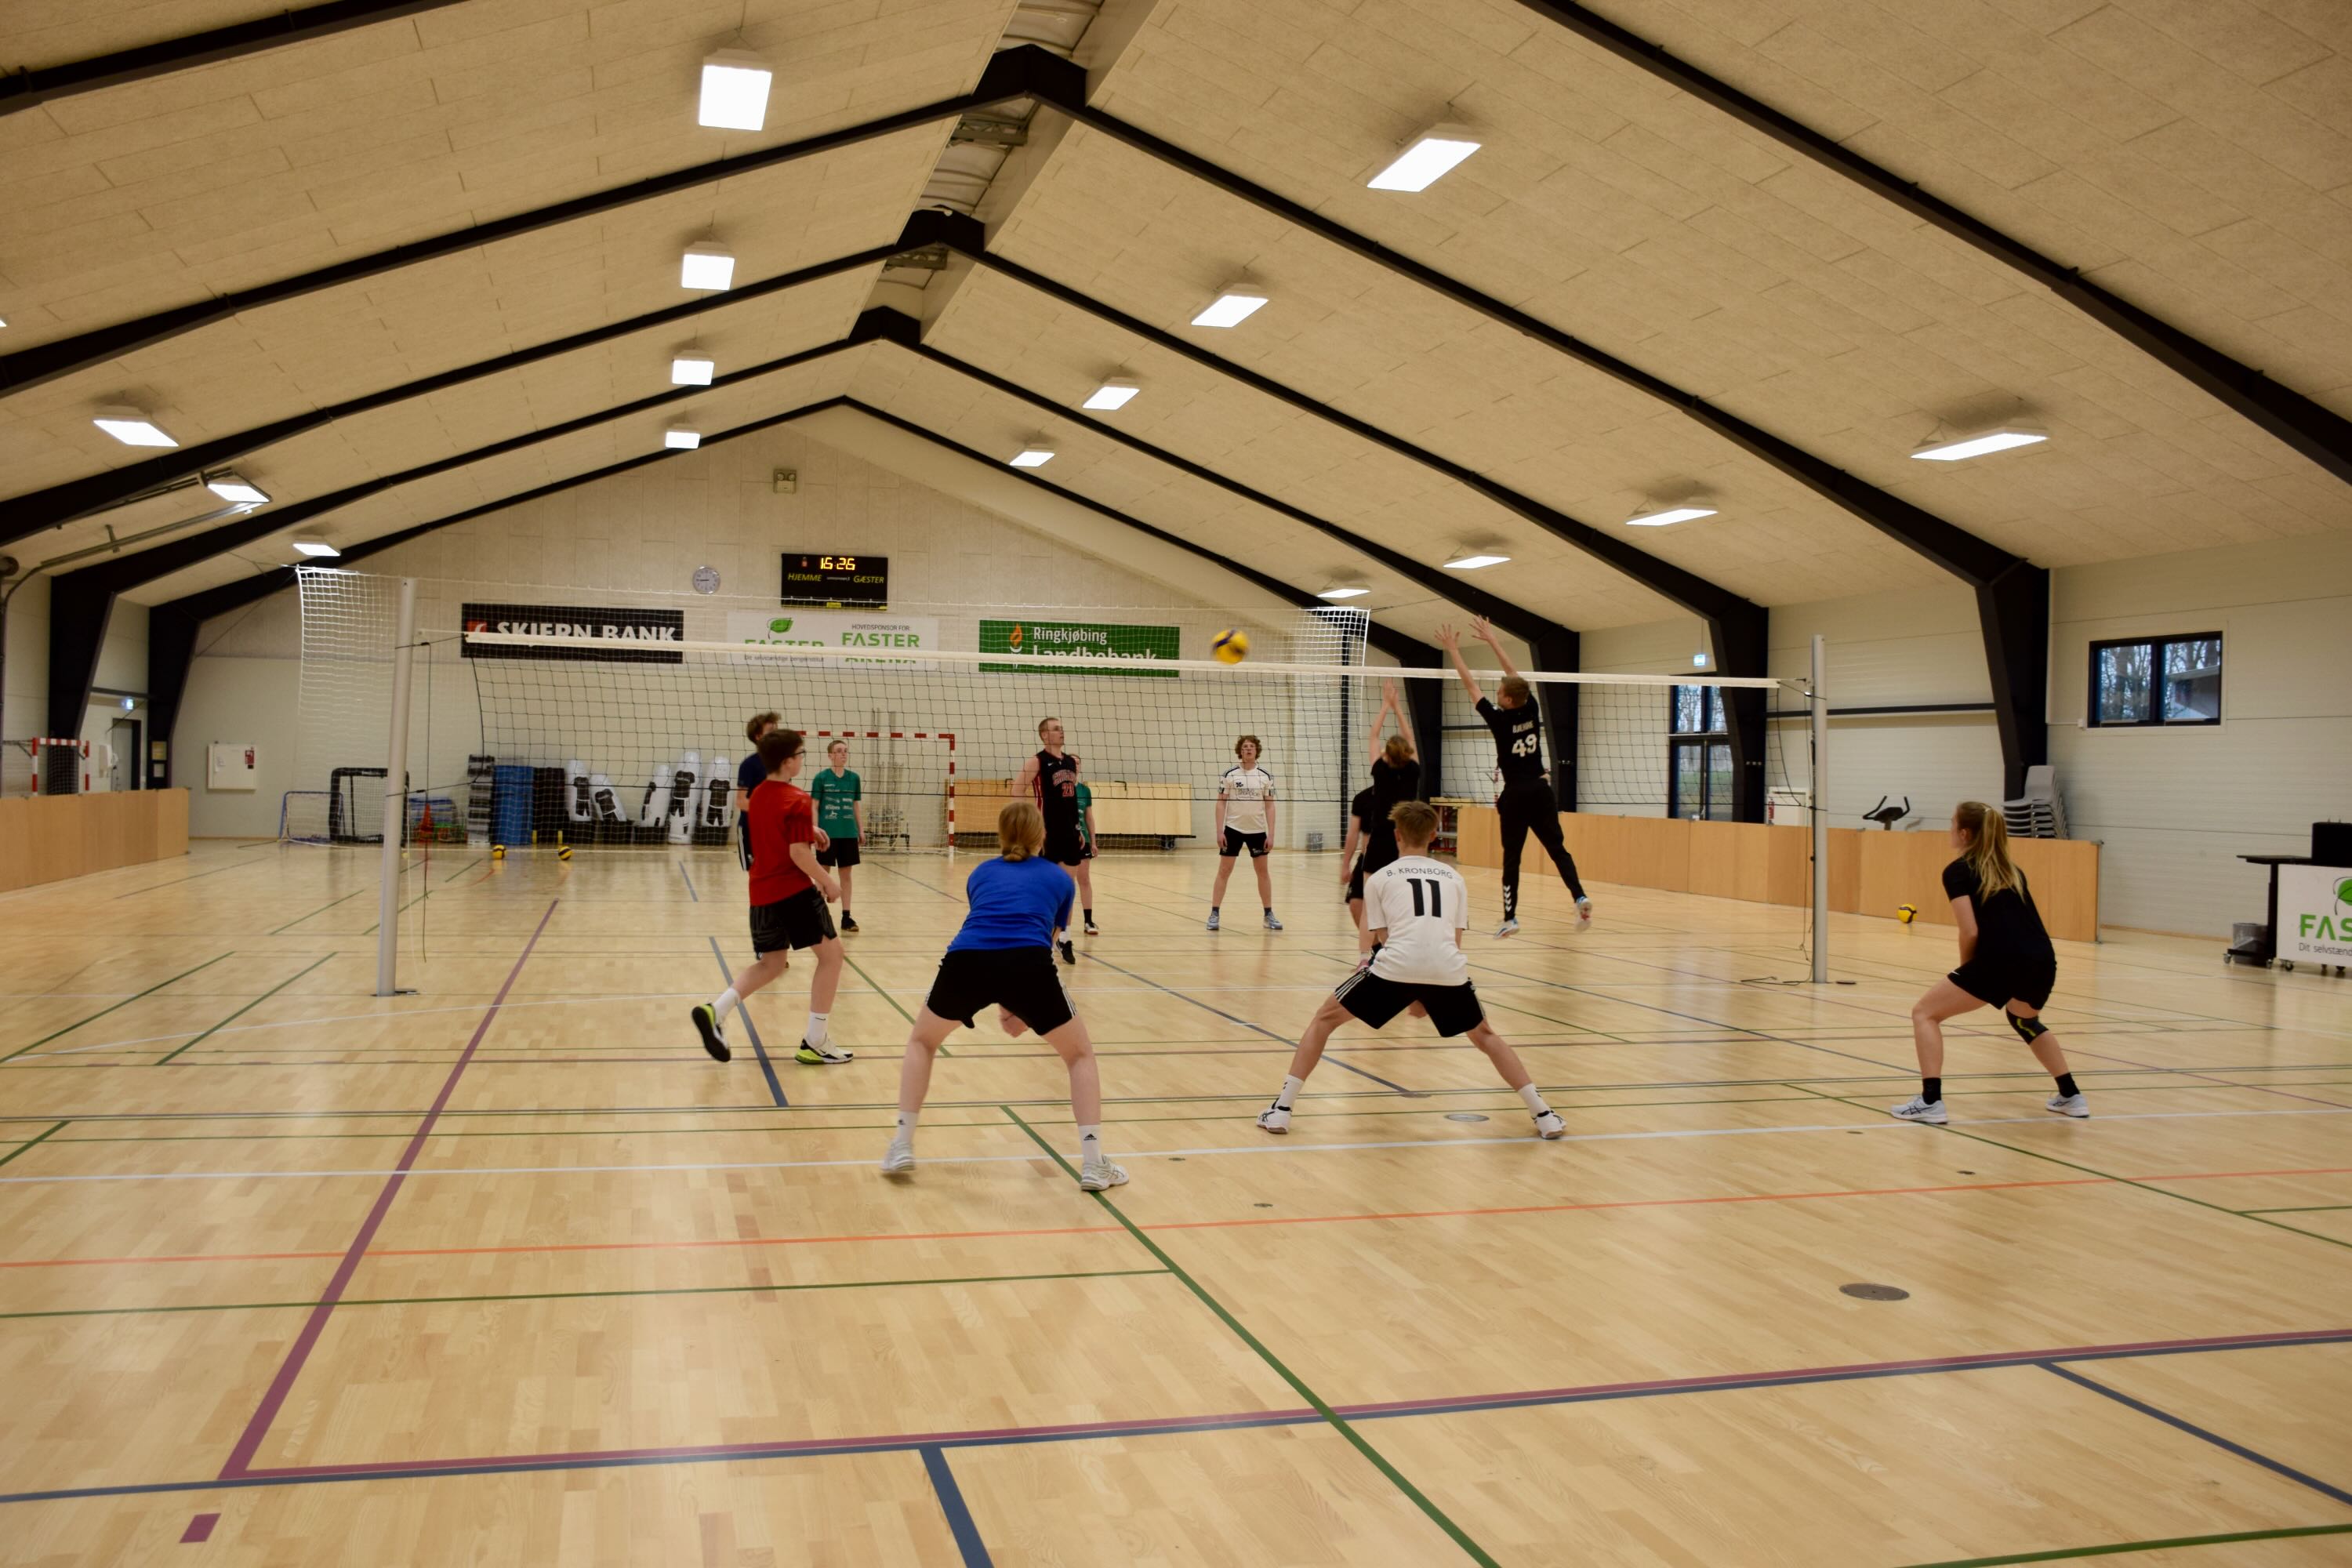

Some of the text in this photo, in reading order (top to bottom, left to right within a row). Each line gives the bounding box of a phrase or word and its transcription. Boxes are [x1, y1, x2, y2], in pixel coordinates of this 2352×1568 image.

[788, 572, 822, 582] HJEMME
[853, 575, 884, 583] GÆSTER
[842, 632, 920, 648] FASTER
[1033, 627, 1108, 645] Ringkjøbing
[1512, 733, 1537, 757] 49
[1398, 867, 1453, 879] KRONBORG
[1406, 878, 1442, 918] 11
